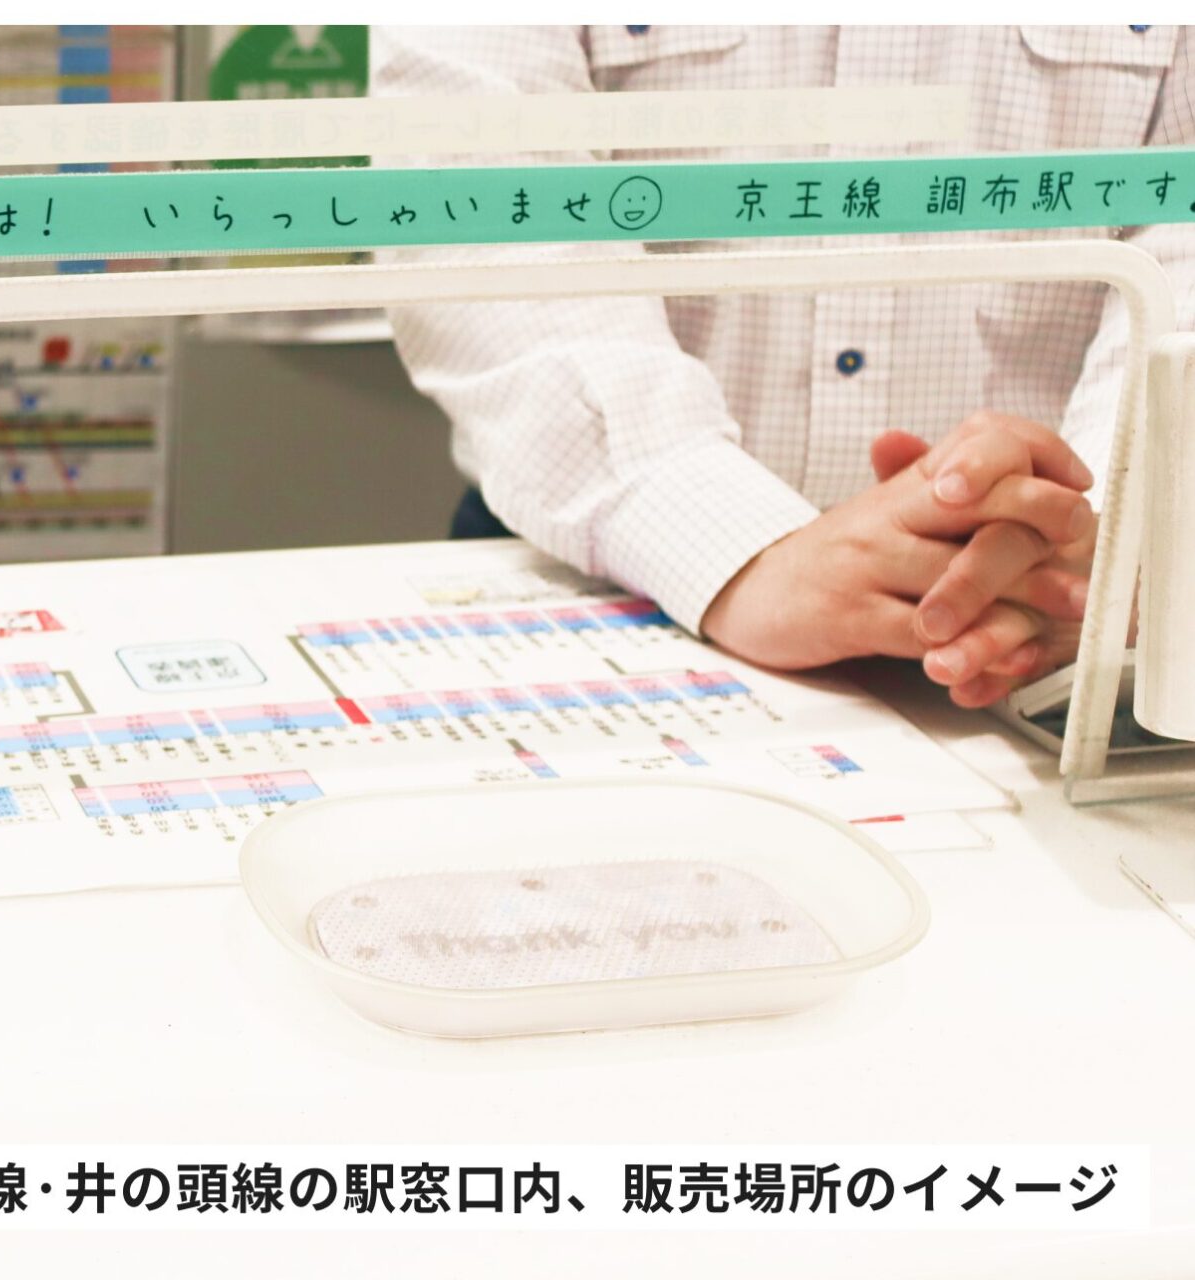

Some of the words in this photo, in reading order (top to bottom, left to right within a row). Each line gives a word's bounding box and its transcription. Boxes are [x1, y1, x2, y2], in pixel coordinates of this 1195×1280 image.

[144, 188, 592, 233] いらっしゃいませ
[735, 177, 881, 222] 京王線
